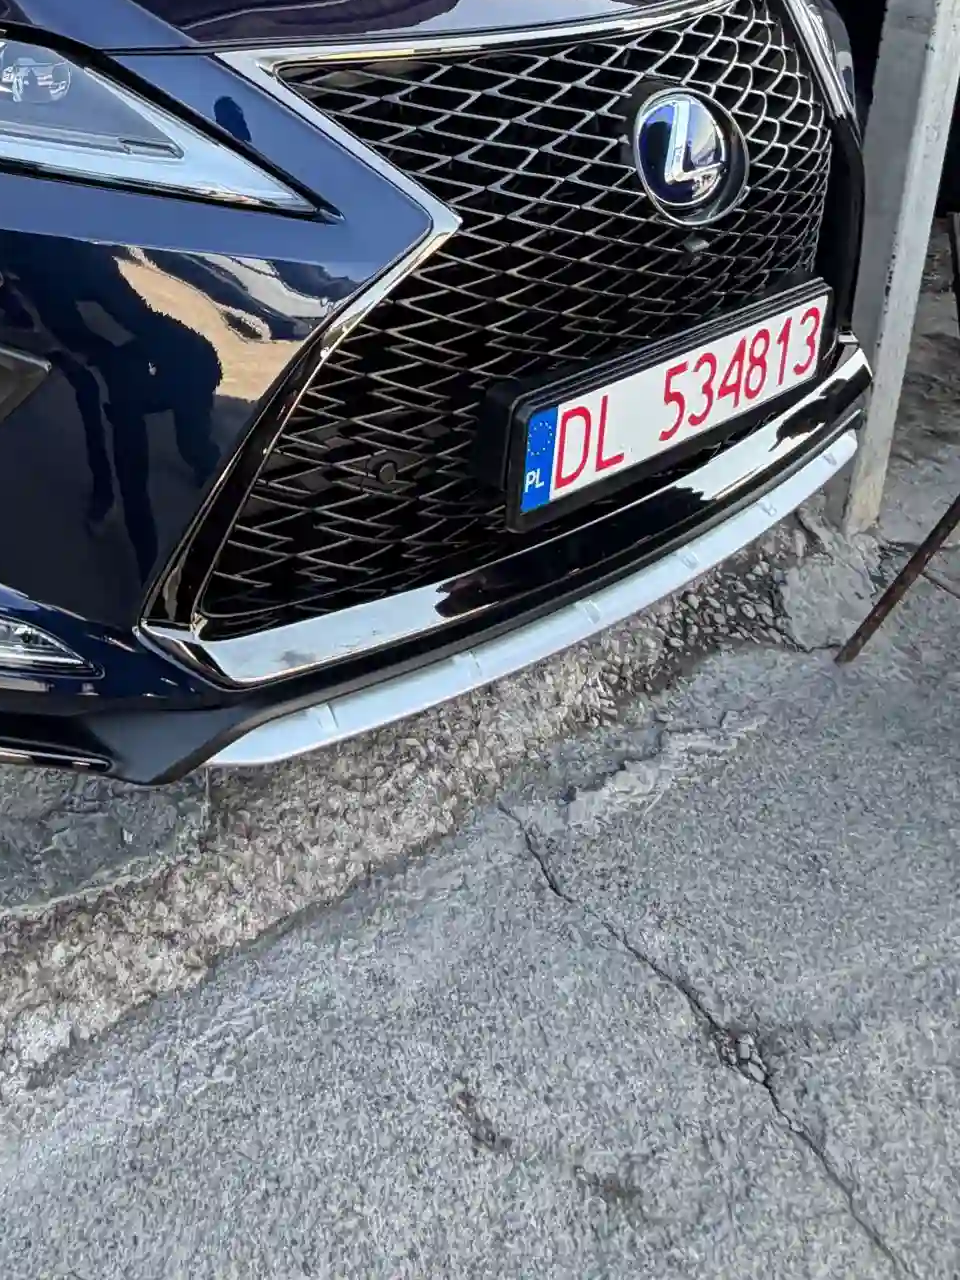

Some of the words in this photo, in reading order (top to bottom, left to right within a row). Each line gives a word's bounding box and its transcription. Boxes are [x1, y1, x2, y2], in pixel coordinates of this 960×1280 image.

[554, 394, 625, 490] DL
[658, 306, 821, 442] 534813
[524, 468, 545, 493] PL
